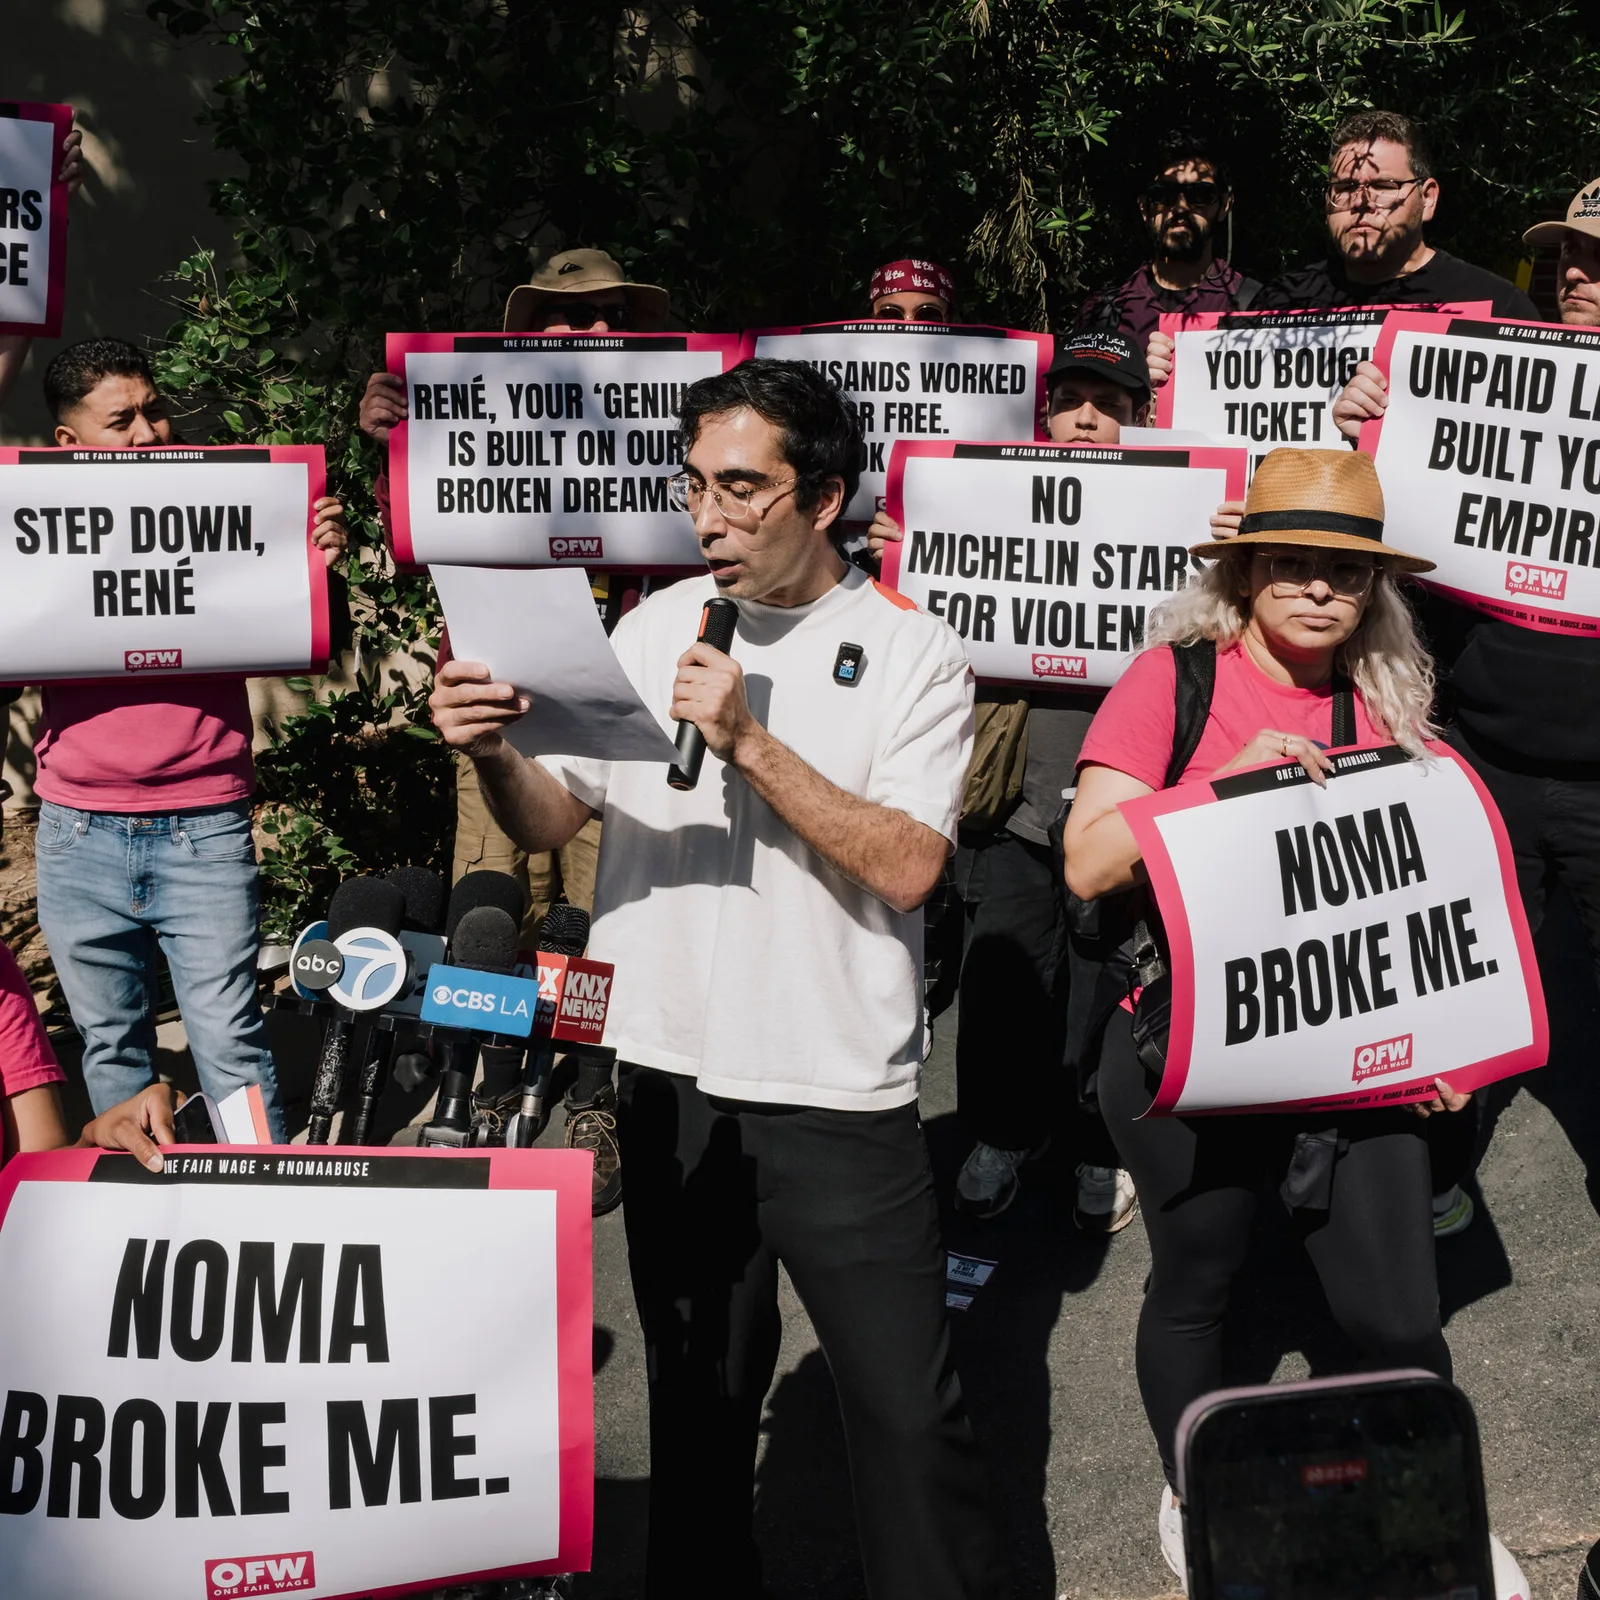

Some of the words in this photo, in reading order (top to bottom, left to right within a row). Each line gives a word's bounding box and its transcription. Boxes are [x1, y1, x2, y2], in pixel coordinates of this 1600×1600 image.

[1498, 326, 1515, 336] ONE
[1517, 328, 1537, 338] FAIR
[1539, 330, 1563, 341] WAGE
[1574, 333, 1600, 346] #NOM
[920, 362, 1026, 394] WORKED
[1205, 350, 1262, 390] YOU
[1409, 345, 1557, 414] UNPAID
[1568, 363, 1600, 422] L
[414, 374, 497, 424] RENÉ,
[506, 382, 583, 420] YOUR
[884, 402, 950, 433] FREE.
[1224, 401, 1326, 442] TICKET
[73, 452, 90, 460] ONE
[93, 452, 112, 460] FAIR
[115, 452, 138, 460] WAGE
[448, 430, 475, 466] IS
[487, 430, 566, 466] BUILT
[577, 430, 615, 466] ON
[1001, 448, 1016, 456] ONE
[1018, 448, 1036, 457] FAIR
[1038, 449, 1060, 458] WAGE
[1428, 417, 1543, 485] BUILT
[437, 477, 552, 513] BROKEN
[1031, 475, 1082, 526] NO
[13, 507, 114, 555] STEP
[130, 505, 265, 556] DOWN,
[552, 539, 599, 552] OFW
[1454, 492, 1600, 568] EMPIR
[907, 531, 1080, 587] MICHELIN
[93, 556, 196, 617] RENÉ
[1509, 565, 1564, 589] OFW
[1542, 587, 1562, 596] WAGE
[927, 589, 996, 642] FOR
[128, 651, 178, 665] OFW
[1034, 656, 1082, 671] OFW
[1276, 768, 1293, 780] ONE
[1275, 802, 1427, 917] NOMA
[297, 953, 340, 974] abc
[1224, 922, 1398, 1046] BROKE
[1406, 897, 1499, 997] ME.
[564, 970, 610, 1002] KNX
[452, 989, 496, 1012] CBS
[500, 999, 528, 1018] LA
[561, 997, 606, 1020] NEWS
[1356, 1068, 1370, 1076] ONE
[1372, 1065, 1388, 1073] FAIR
[1390, 1058, 1409, 1068] WAGE
[1357, 1038, 1409, 1069] OFW
[182, 1159, 212, 1174] FAIR
[219, 1159, 257, 1174] WAGE
[277, 1160, 369, 1176] #NOMAABUSE
[107, 1237, 390, 1363] NOMA
[0, 1389, 290, 1520] BROKE
[326, 1393, 510, 1510] ME.
[211, 1556, 307, 1588] OFW
[213, 1587, 239, 1596] ONE
[243, 1584, 270, 1593] FAIR
[275, 1579, 309, 1589] WAGE
